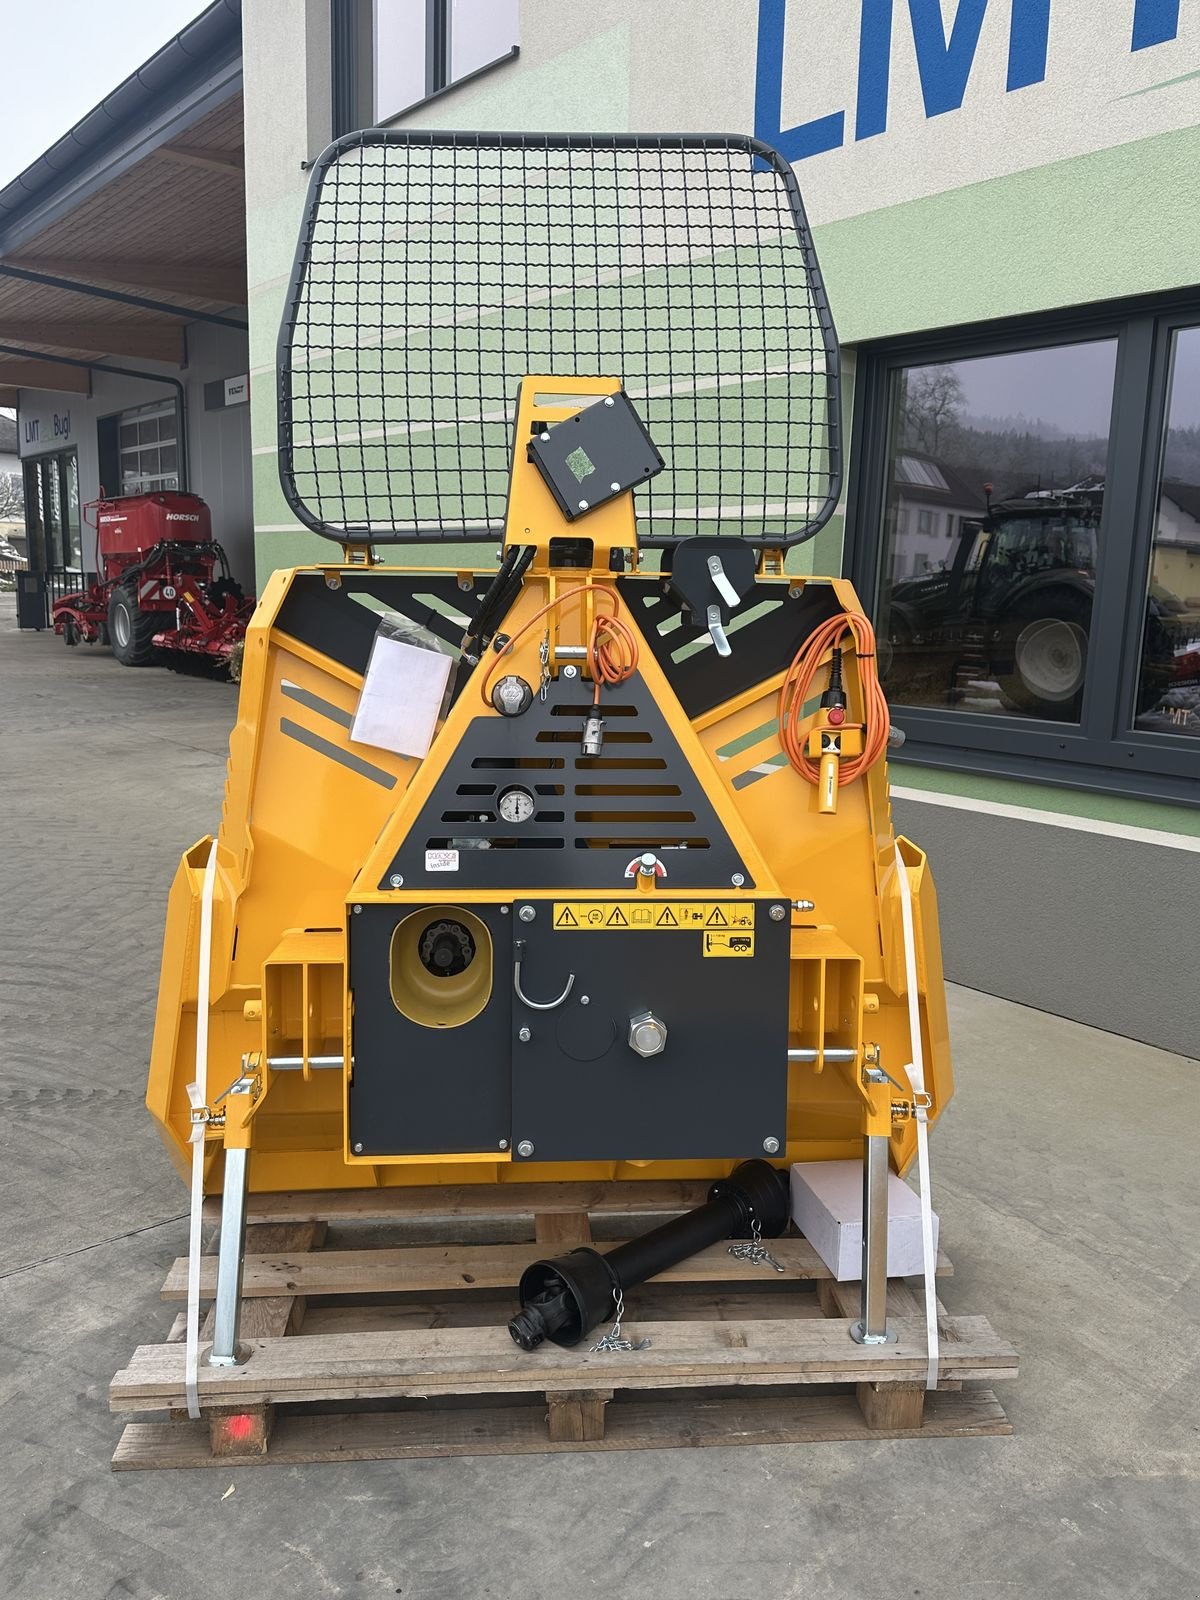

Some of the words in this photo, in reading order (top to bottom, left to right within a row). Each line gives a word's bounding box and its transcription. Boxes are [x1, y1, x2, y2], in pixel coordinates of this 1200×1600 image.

[754, 0, 1181, 176] LM
[25, 419, 40, 443] LMT
[54, 410, 71, 440] Bugl
[36, 463, 45, 522] KRONE
[166, 513, 200, 522] HORSCH
[165, 588, 174, 597] 40
